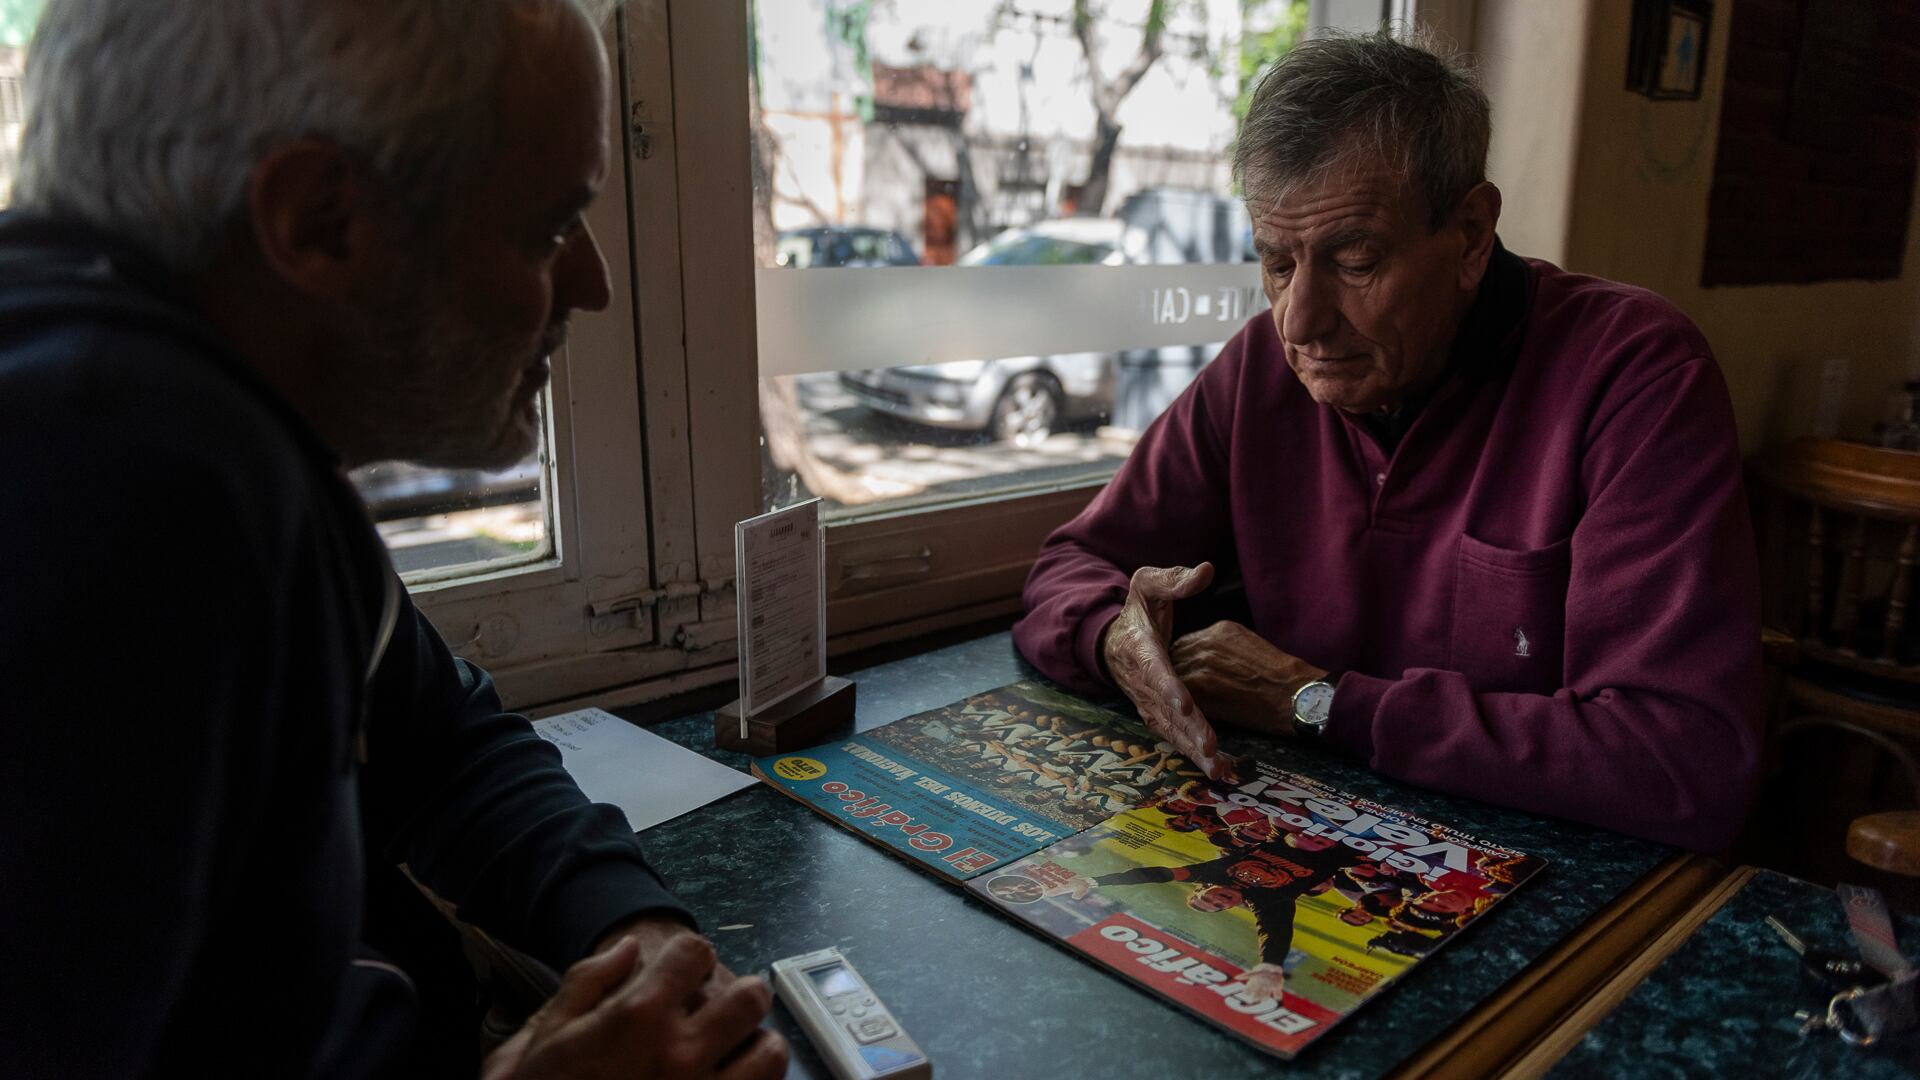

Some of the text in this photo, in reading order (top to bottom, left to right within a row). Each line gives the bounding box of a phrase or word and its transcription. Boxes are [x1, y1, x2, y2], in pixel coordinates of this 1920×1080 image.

[914, 776, 951, 795] DEL
[821, 781, 954, 852] Gráfico
[1237, 775, 1468, 873] Vélez!
[1408, 815, 1429, 825] EN
[1011, 822, 1056, 843] LOS
[1227, 793, 1450, 882] ¡Glorioso
[1479, 839, 1528, 857] SEXTO
[942, 847, 1000, 874] El
